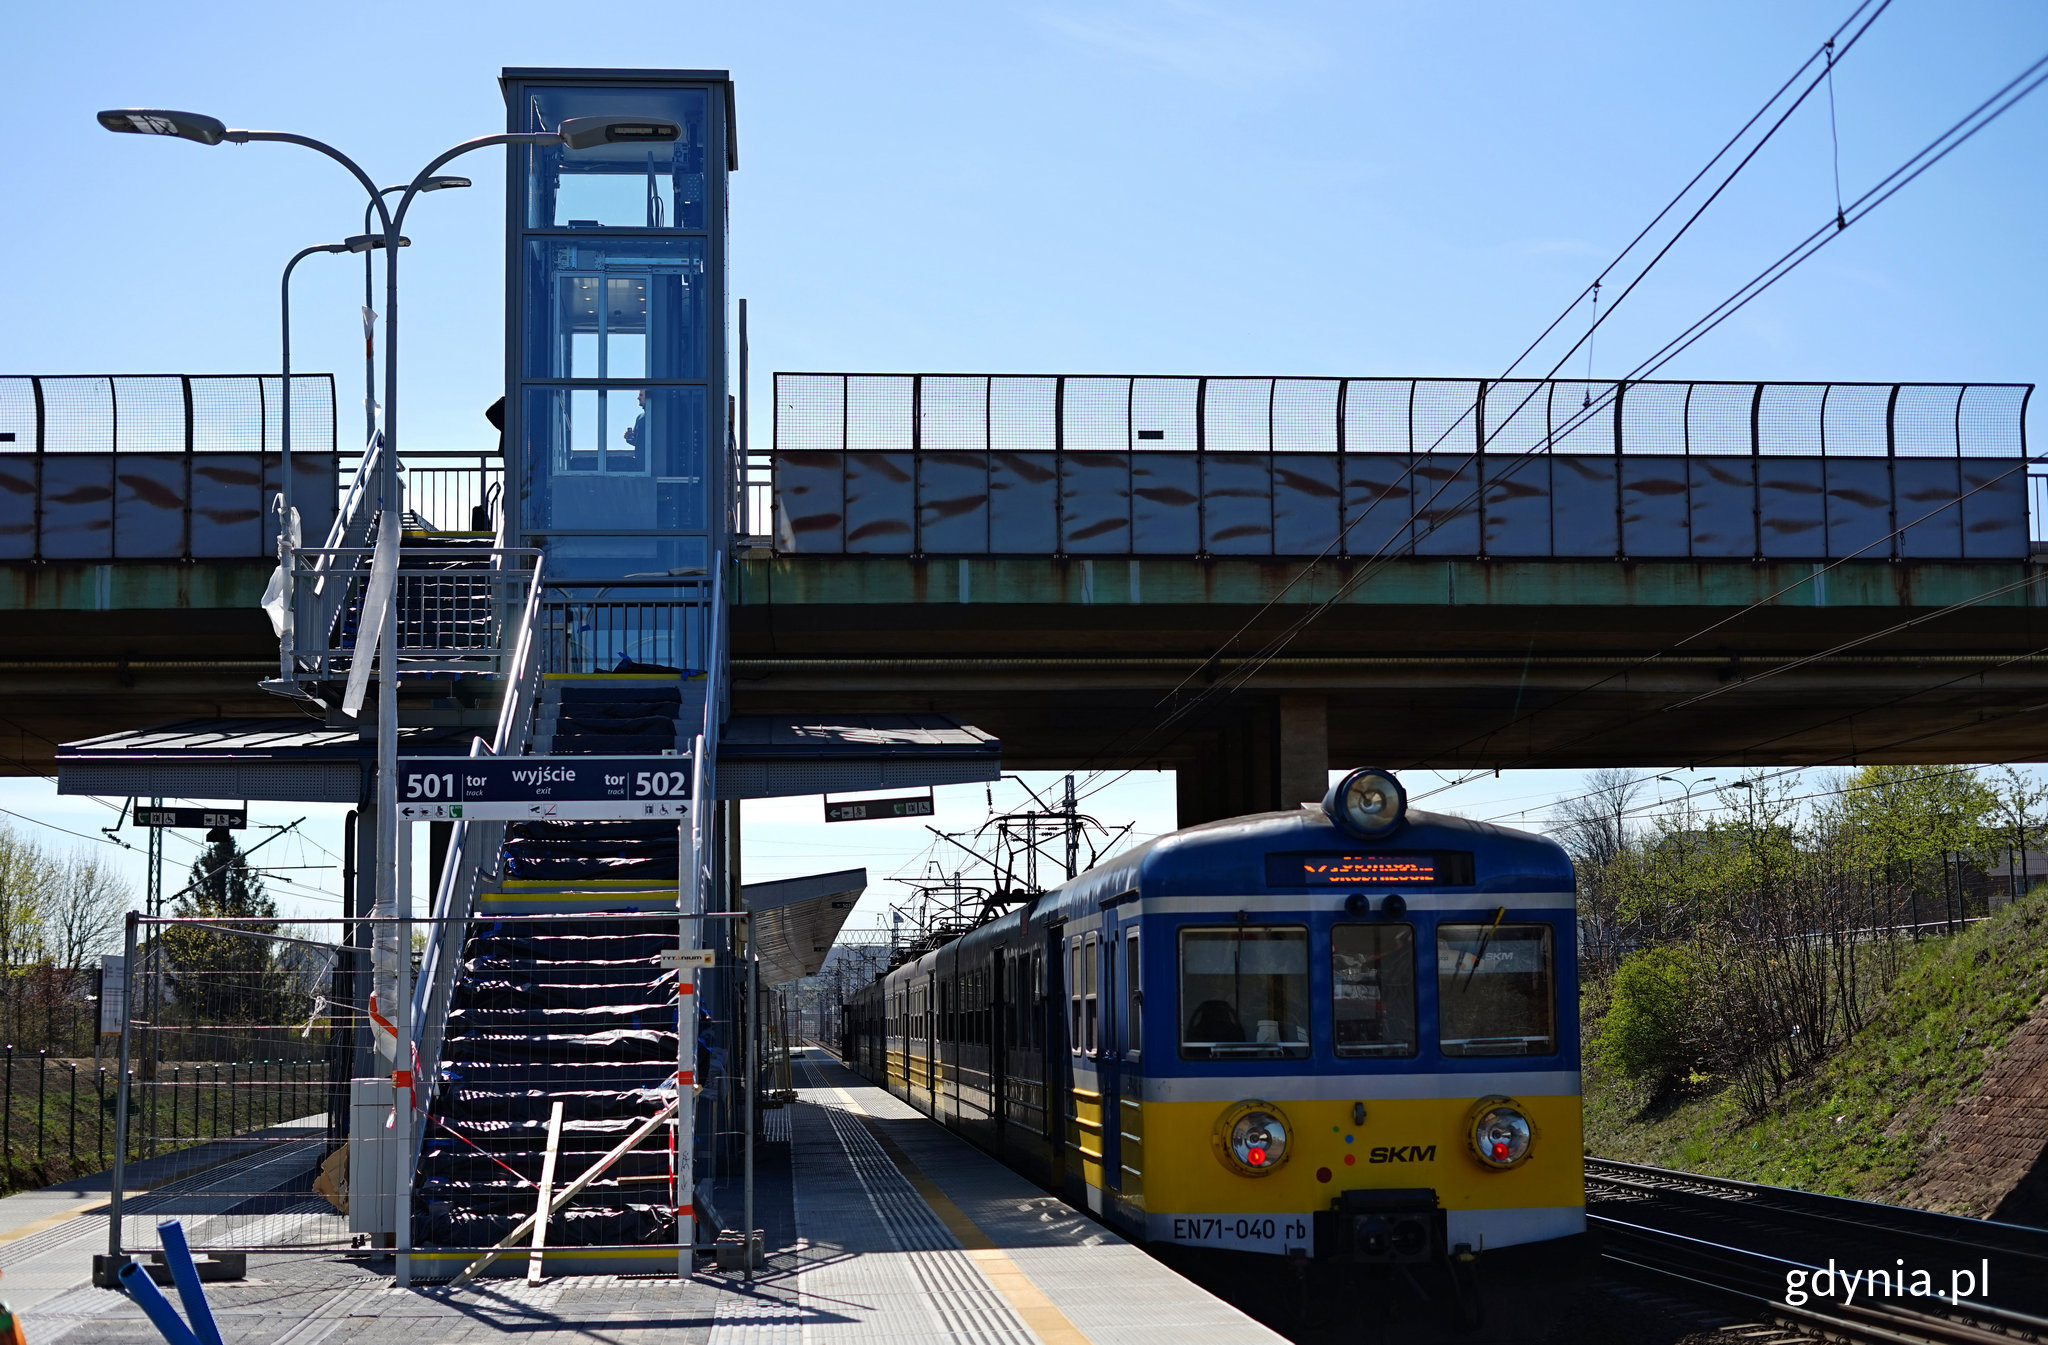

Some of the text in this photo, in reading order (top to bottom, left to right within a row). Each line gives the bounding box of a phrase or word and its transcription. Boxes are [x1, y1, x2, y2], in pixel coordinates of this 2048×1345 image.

[406, 773, 453, 798] 501
[466, 775, 487, 786] tor
[512, 766, 576, 786] wyjście
[604, 774, 625, 785] tor
[635, 771, 685, 796] 502
[466, 789, 484, 797] track
[535, 787, 552, 795] exit
[1368, 1145, 1437, 1164] SKM
[1173, 1218, 1306, 1240] EN71-040 rb
